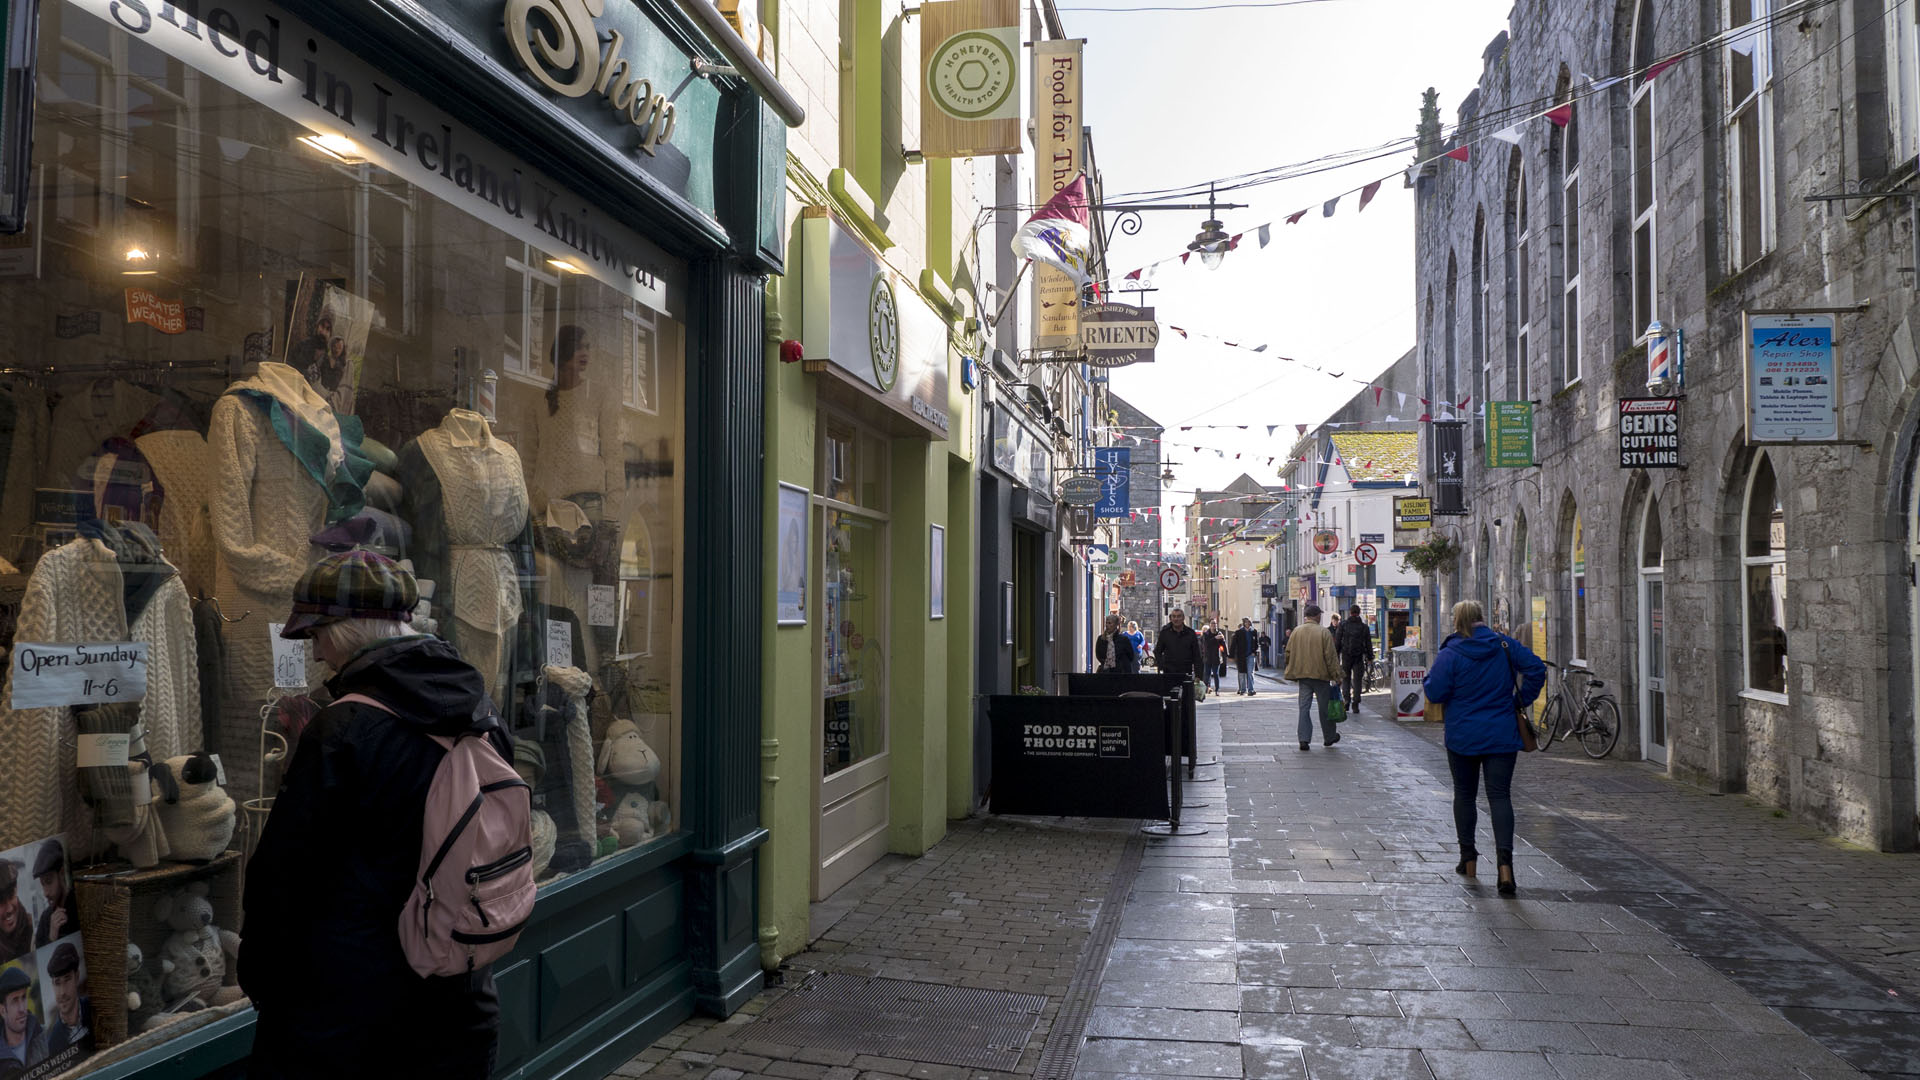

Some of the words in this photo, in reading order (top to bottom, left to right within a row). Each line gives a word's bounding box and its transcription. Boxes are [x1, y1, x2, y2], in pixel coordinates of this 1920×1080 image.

[945, 45, 1000, 68] HONEYBEE
[504, 0, 676, 157] Shop
[1052, 57, 1073, 106] Food
[944, 82, 974, 105] HEALTH
[976, 79, 1001, 104] STORE
[1052, 113, 1073, 142] for
[302, 38, 356, 126] in
[371, 83, 524, 219] Ireland
[534, 181, 656, 291] Knitwear
[131, 290, 181, 316] SWEATER
[132, 306, 182, 332] WEATHER
[1042, 312, 1077, 321] Sandwich
[1082, 326, 1157, 344] RMENTS
[1760, 331, 1824, 348] Alex
[1096, 351, 1137, 365] GALWAY
[1762, 350, 1794, 359] Repair
[1799, 349, 1824, 359] Shop
[1621, 413, 1677, 434] GENTS
[1621, 435, 1677, 448] CUTTING
[1622, 451, 1677, 464] STYLING
[1107, 451, 1118, 507] HYNES
[20, 648, 69, 676] Open
[74, 645, 138, 669] Sunday
[1411, 670, 1425, 679] CUT
[1024, 724, 1063, 735] FOOD
[1068, 725, 1097, 736] FOR
[1023, 737, 1097, 748] THOUGHT
[1101, 738, 1127, 746] winning
[49, 1046, 79, 1067] WEAVERS
